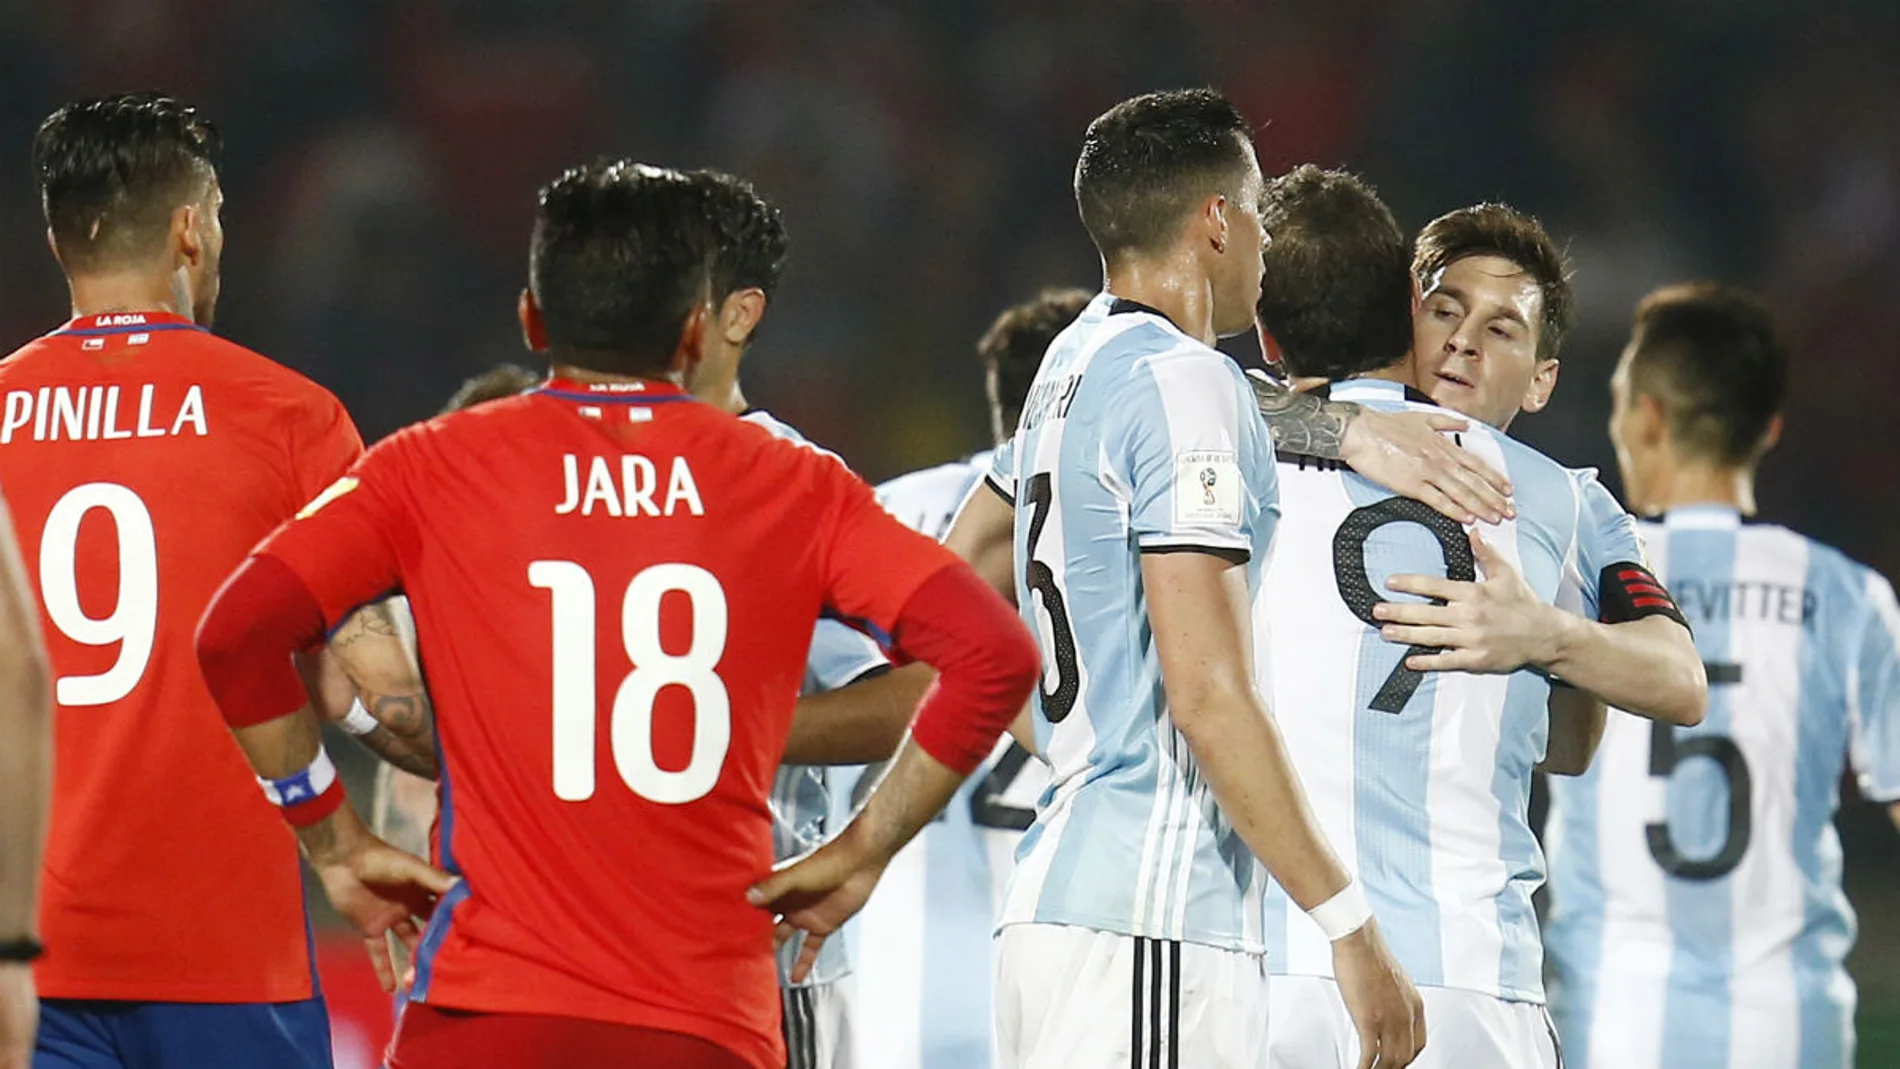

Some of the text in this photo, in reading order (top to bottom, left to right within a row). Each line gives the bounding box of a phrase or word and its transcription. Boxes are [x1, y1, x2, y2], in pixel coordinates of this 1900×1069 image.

[96, 315, 146, 326] LA ROJA
[1, 383, 208, 444] PINILLA
[555, 453, 705, 517] JARA
[39, 482, 158, 706] 9
[1333, 495, 1476, 715] 9
[1672, 578, 1818, 634] EVITTER
[528, 560, 731, 804] 18
[1644, 663, 1754, 881] 5
